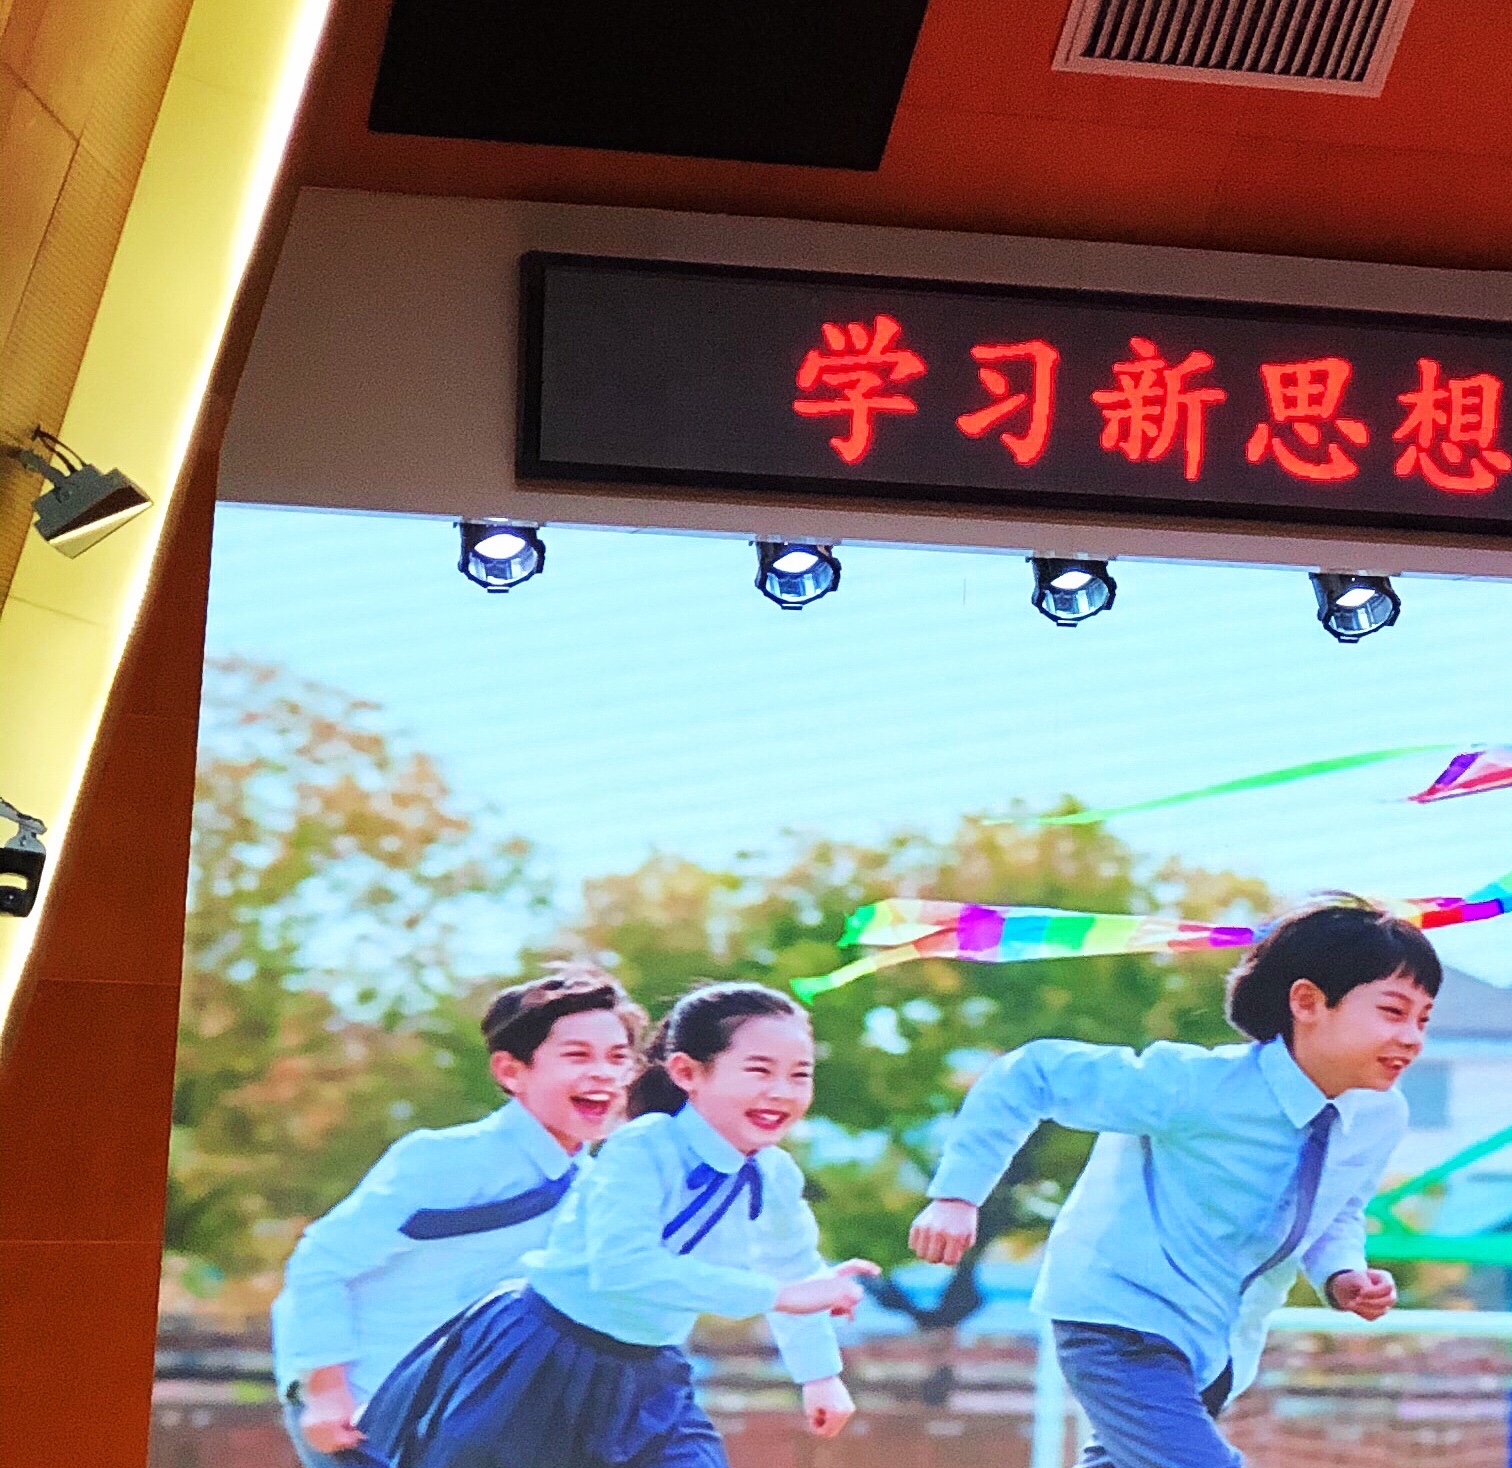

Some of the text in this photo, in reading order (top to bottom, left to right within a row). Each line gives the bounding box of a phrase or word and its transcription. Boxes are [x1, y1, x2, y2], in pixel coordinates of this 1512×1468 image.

[793, 314, 1512, 494] 学习新思想
